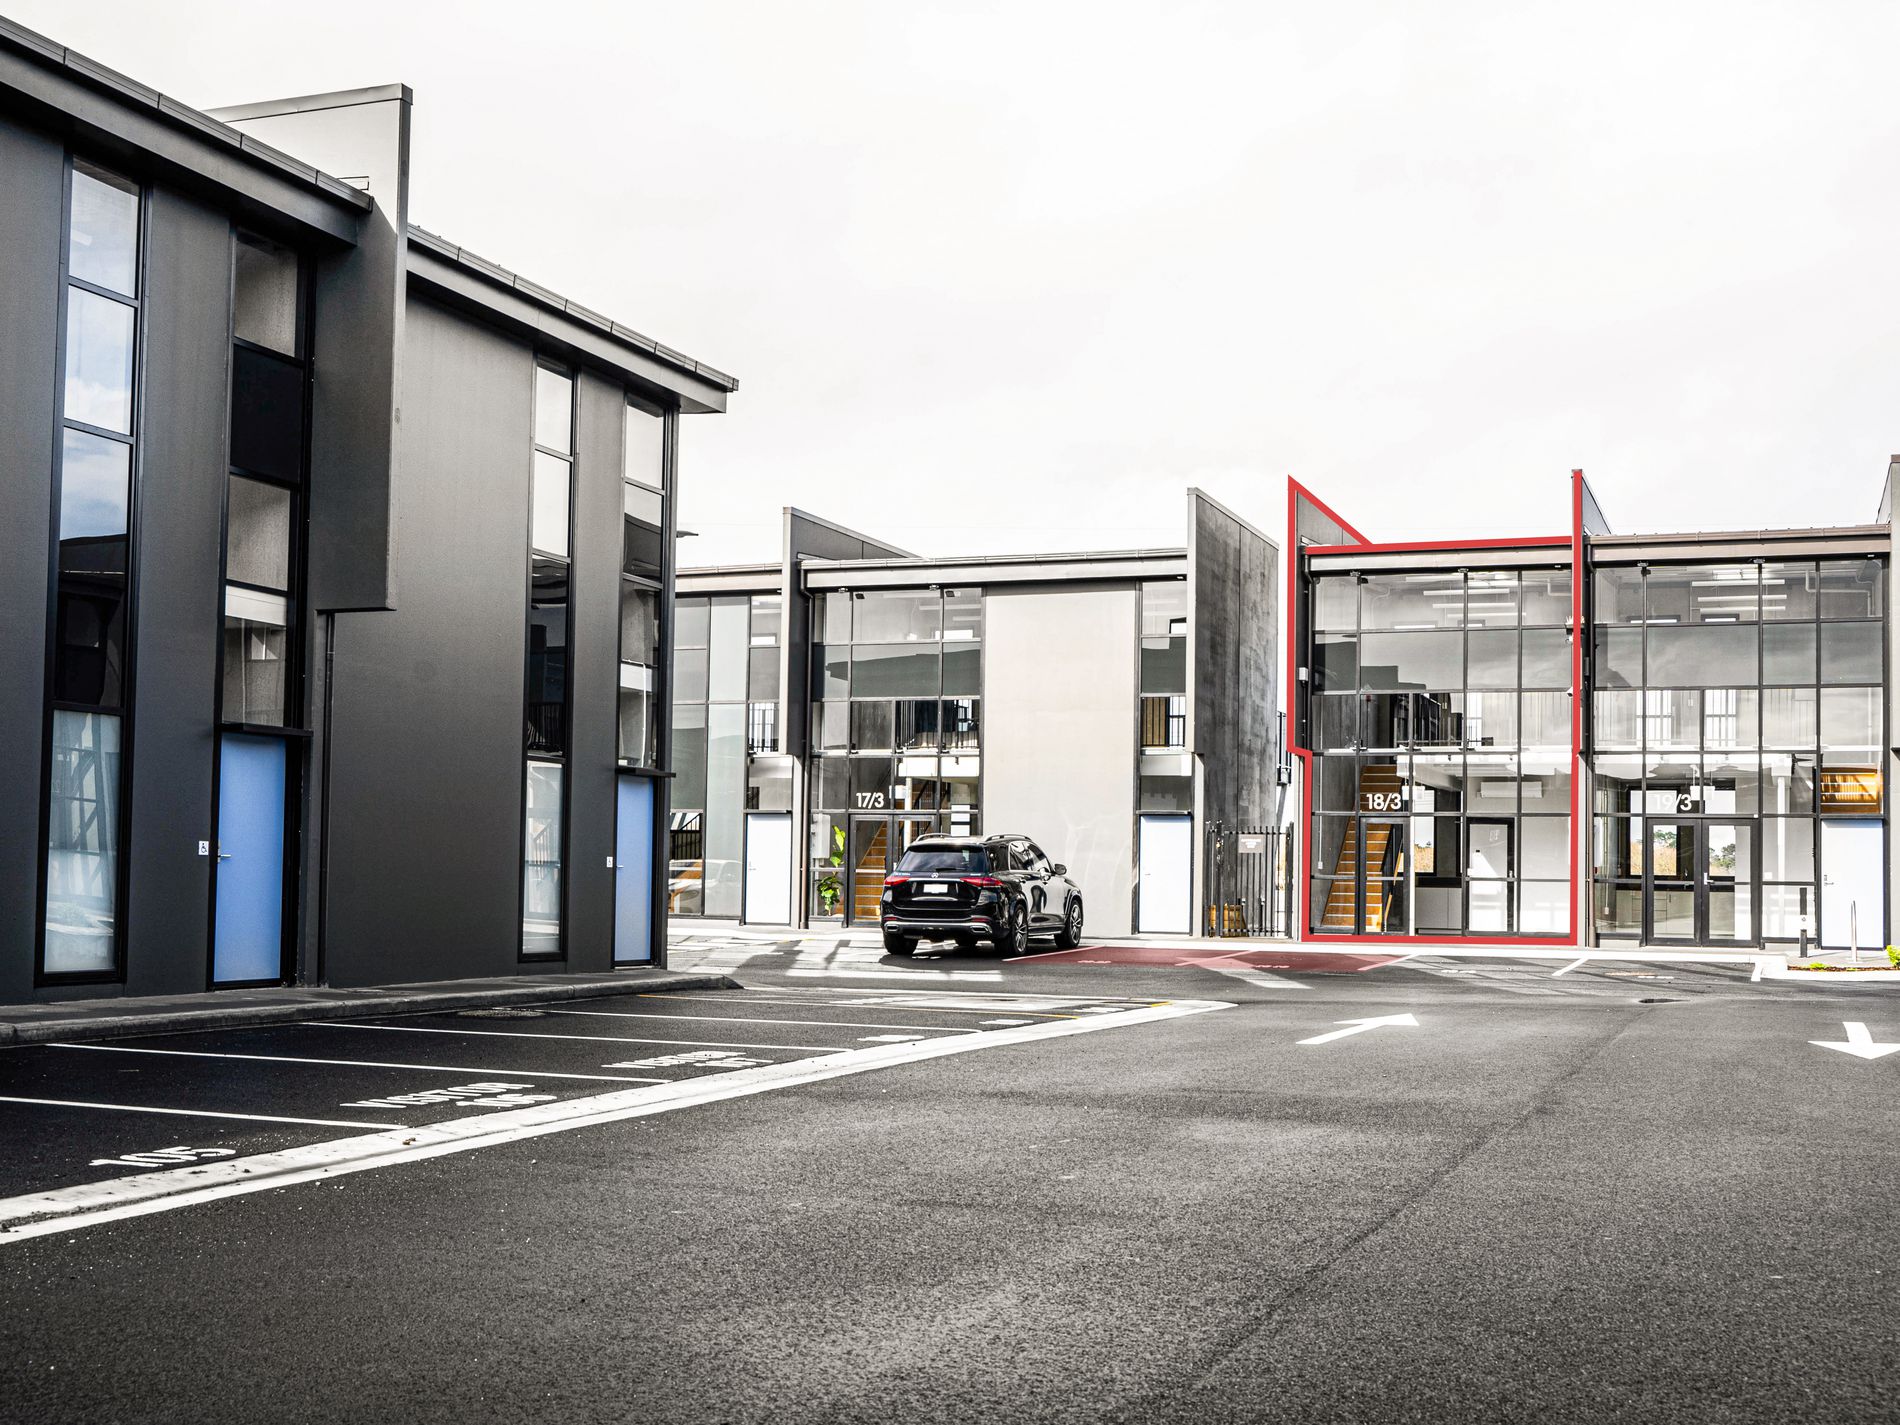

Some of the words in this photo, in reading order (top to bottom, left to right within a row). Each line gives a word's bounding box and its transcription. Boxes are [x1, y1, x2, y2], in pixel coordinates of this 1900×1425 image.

[856, 792, 884, 809] 17/3
[1366, 793, 1401, 811] 18/3
[1654, 793, 1692, 811] 19/3
[340, 1082, 535, 1108] VISITOR
[456, 1093, 557, 1107] 106
[88, 1146, 236, 1168] 105
